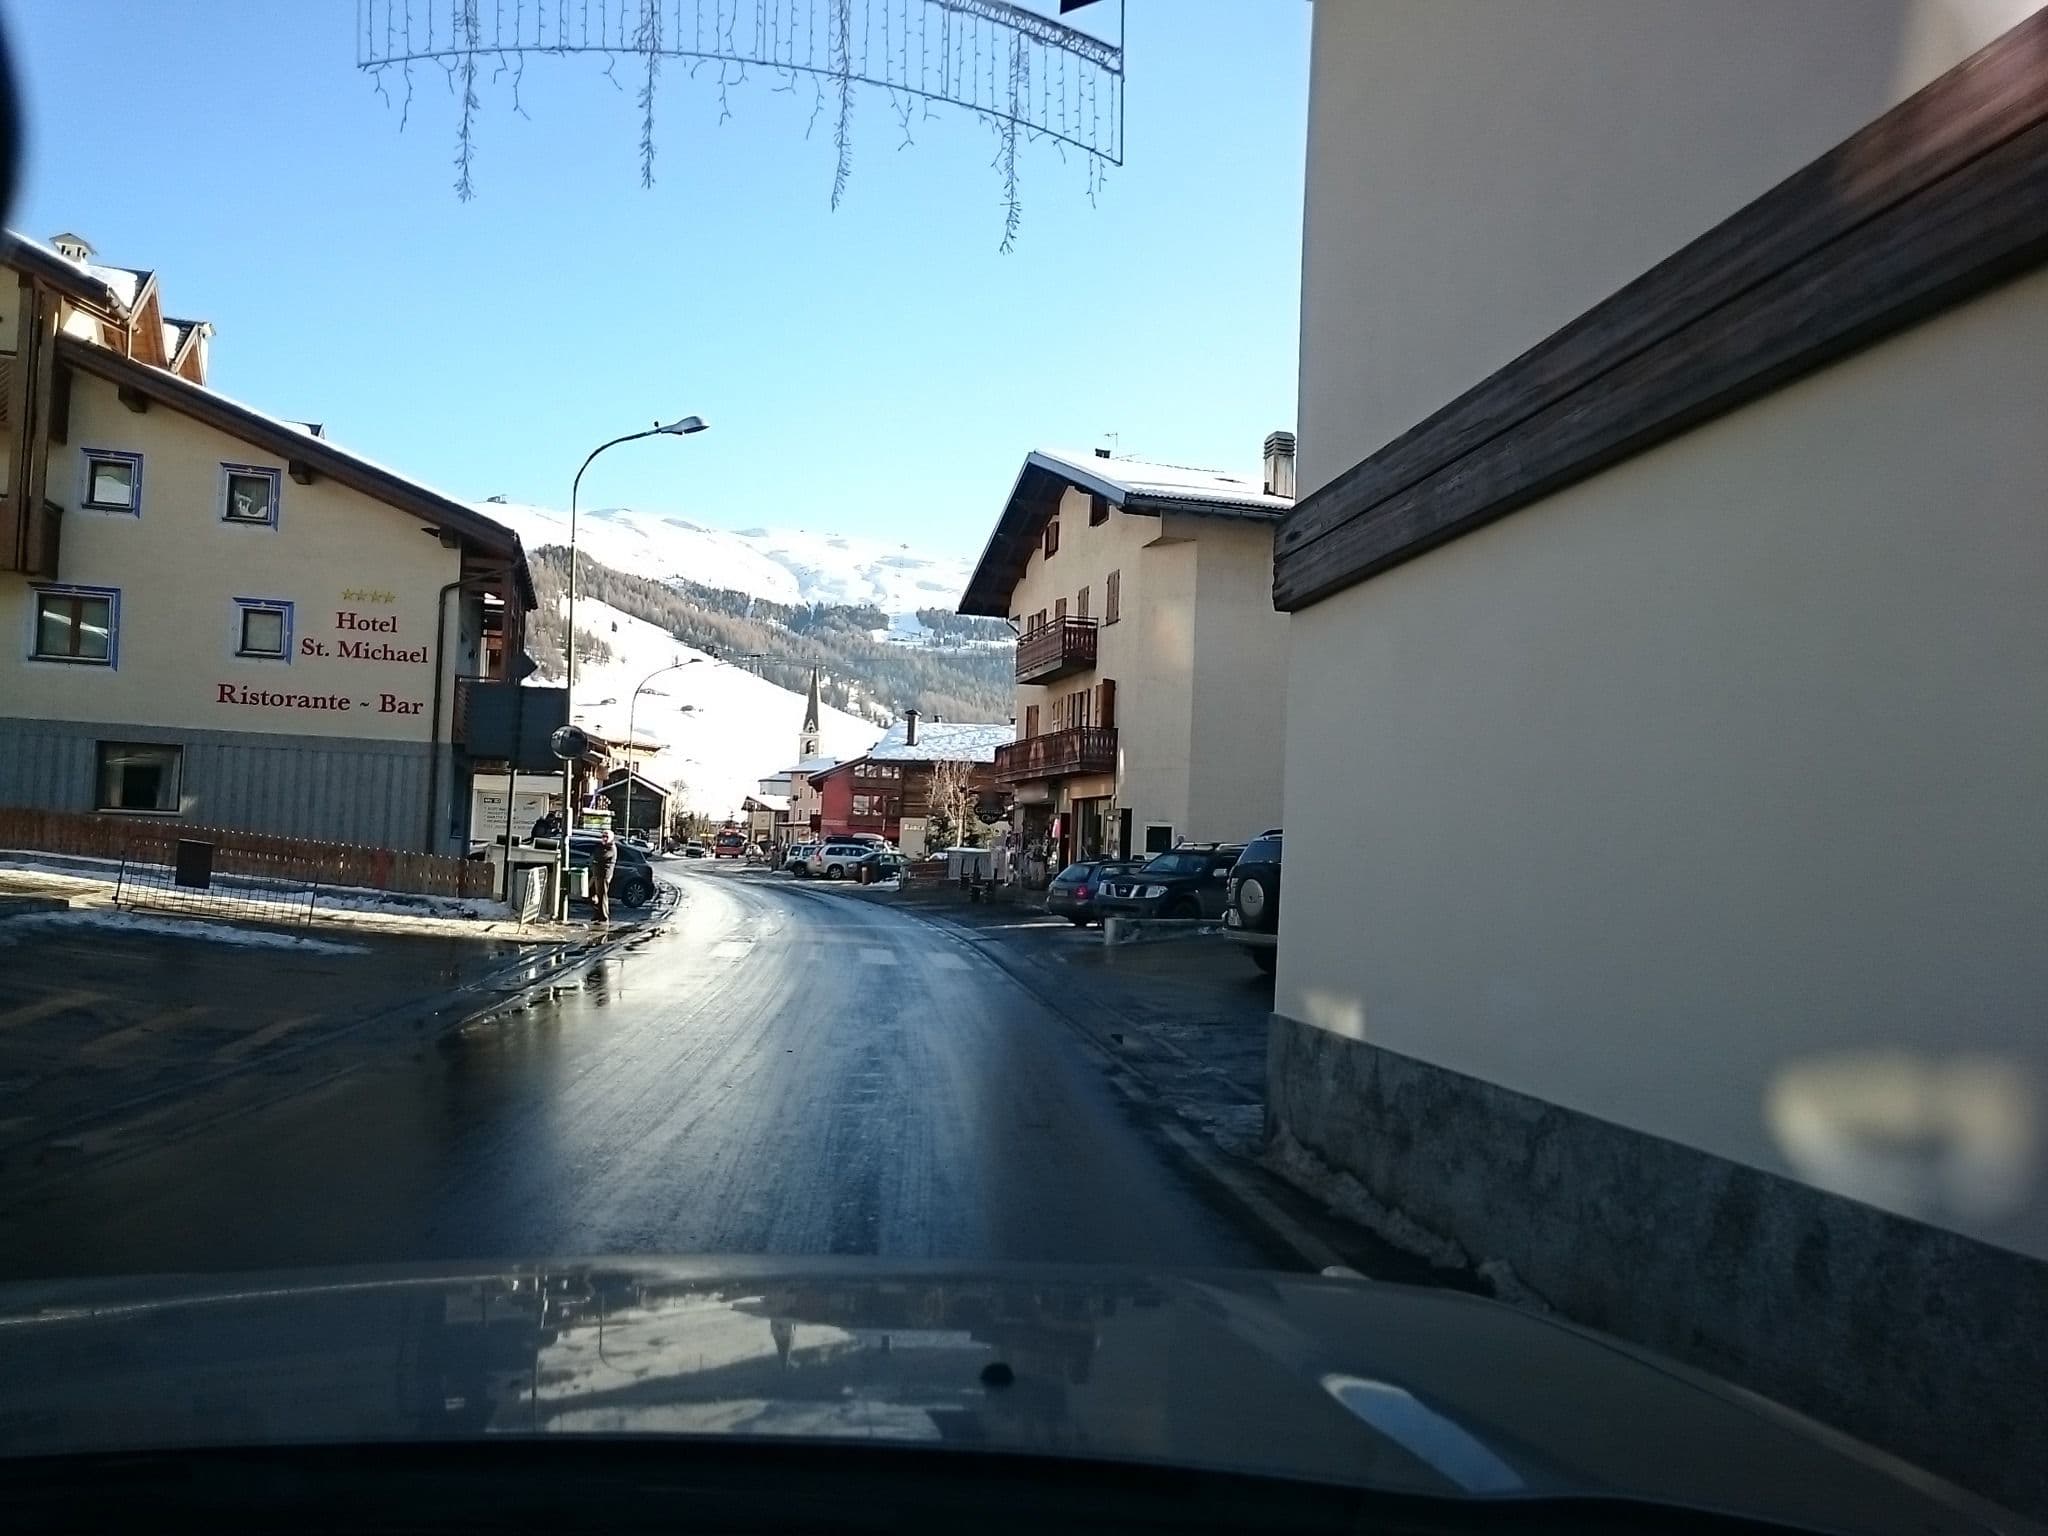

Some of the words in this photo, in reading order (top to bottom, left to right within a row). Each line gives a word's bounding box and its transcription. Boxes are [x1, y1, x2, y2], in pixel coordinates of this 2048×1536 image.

[336, 611, 398, 633] Hotel
[301, 638, 330, 657] St.
[337, 640, 429, 664] Michael
[216, 683, 351, 711] Ristorante
[378, 693, 424, 715] Bar
